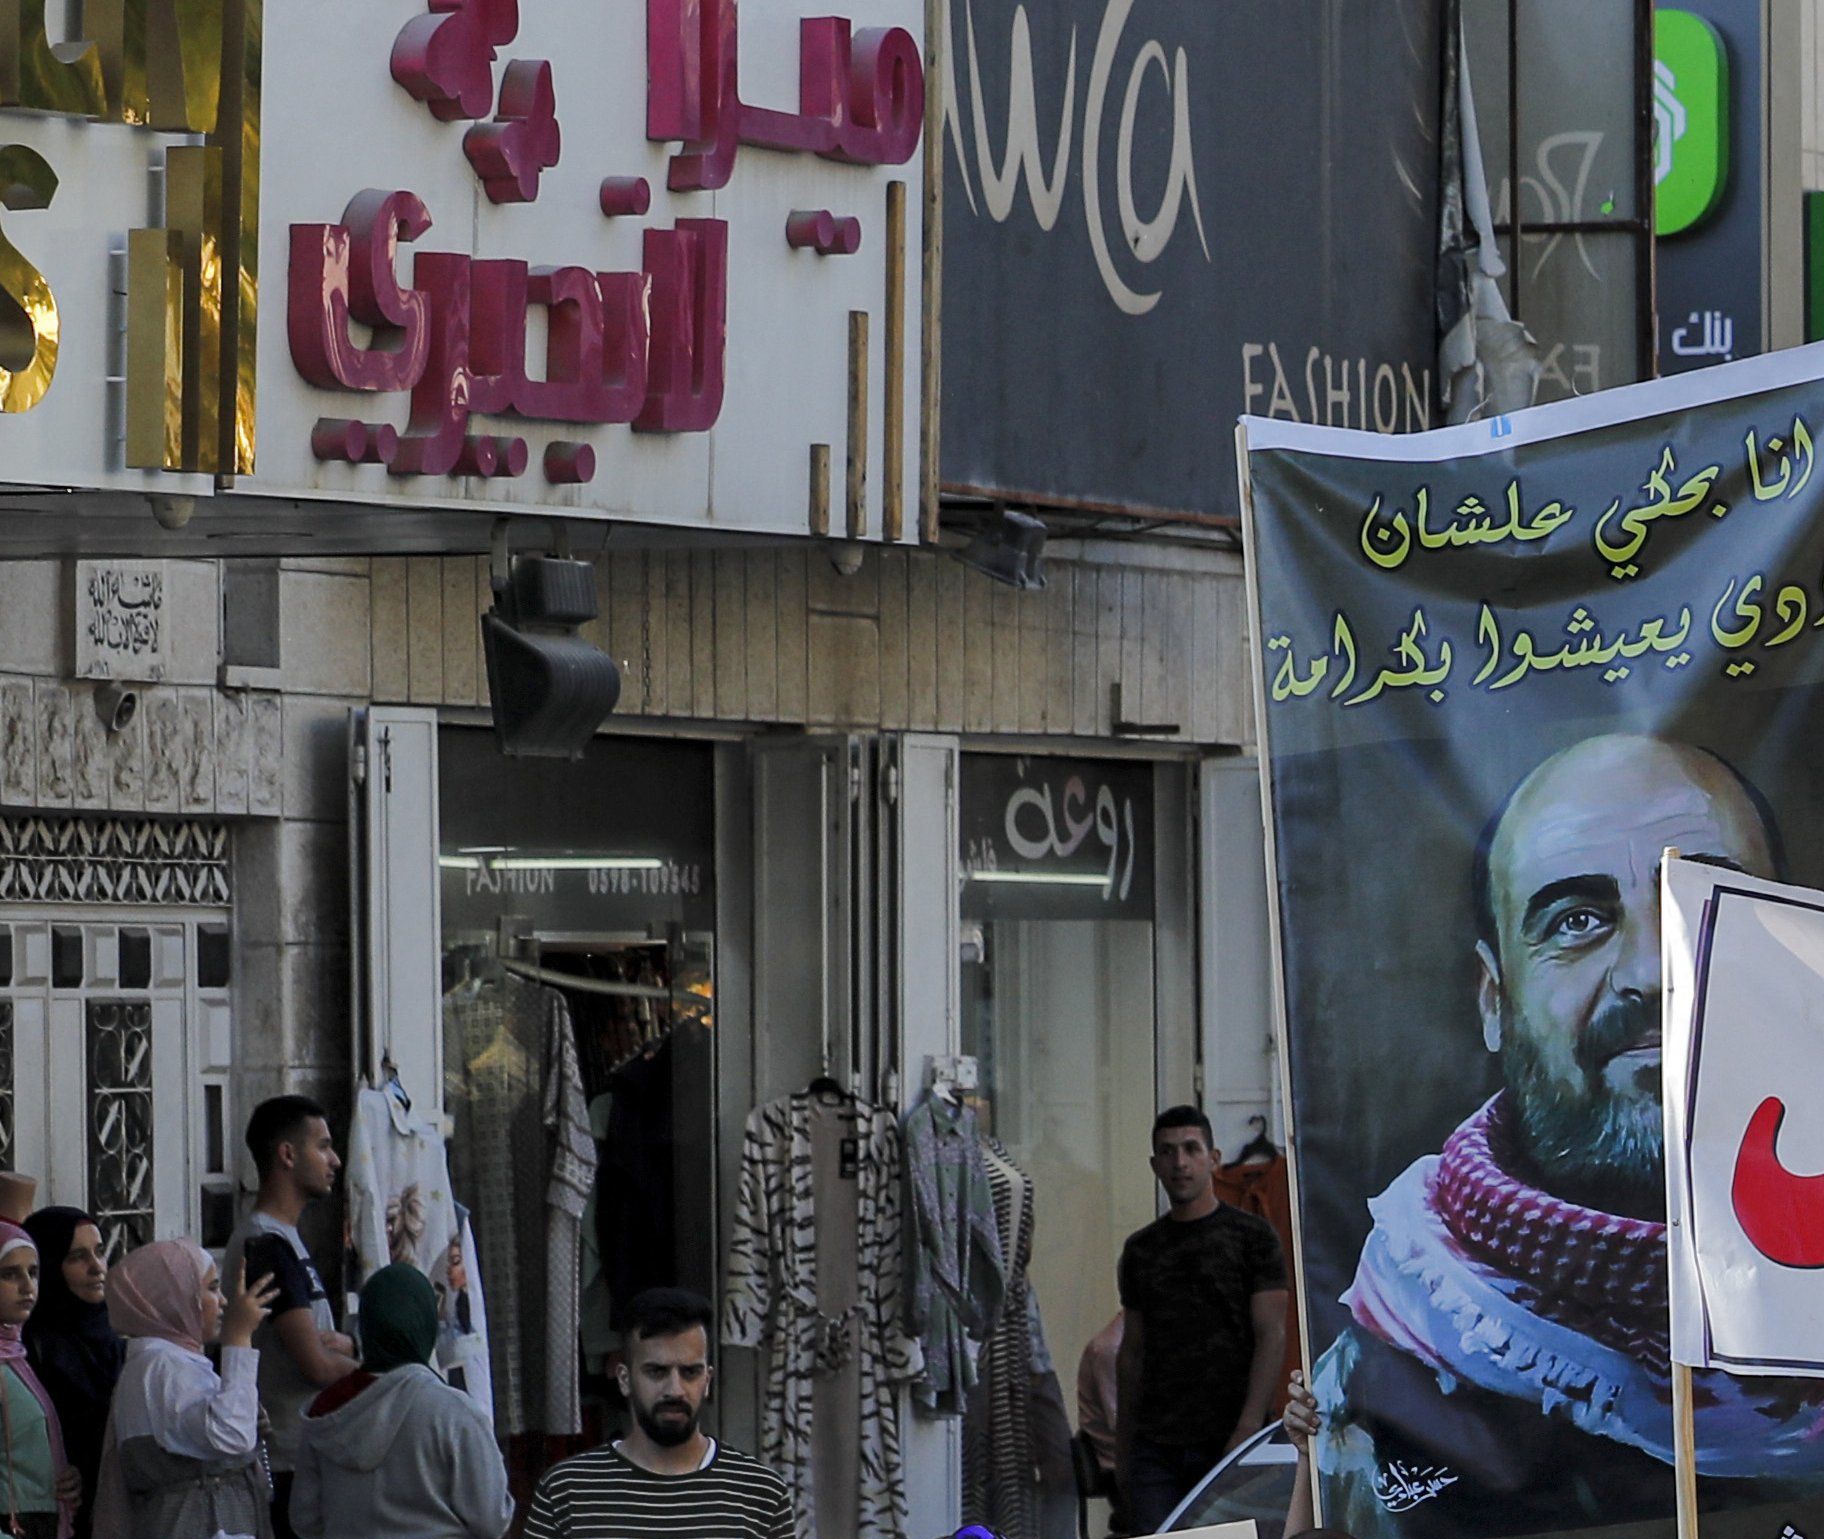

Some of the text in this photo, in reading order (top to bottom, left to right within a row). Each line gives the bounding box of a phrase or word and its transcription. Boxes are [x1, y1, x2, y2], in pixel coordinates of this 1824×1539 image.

[1671, 311, 1733, 361] بنك
[1242, 341, 1430, 436] FASHION
[1361, 481, 1573, 569] علشان
[1594, 447, 1727, 577] بحكي
[1266, 609, 1453, 707] بكرامة
[1473, 603, 1692, 691] يعيشوا
